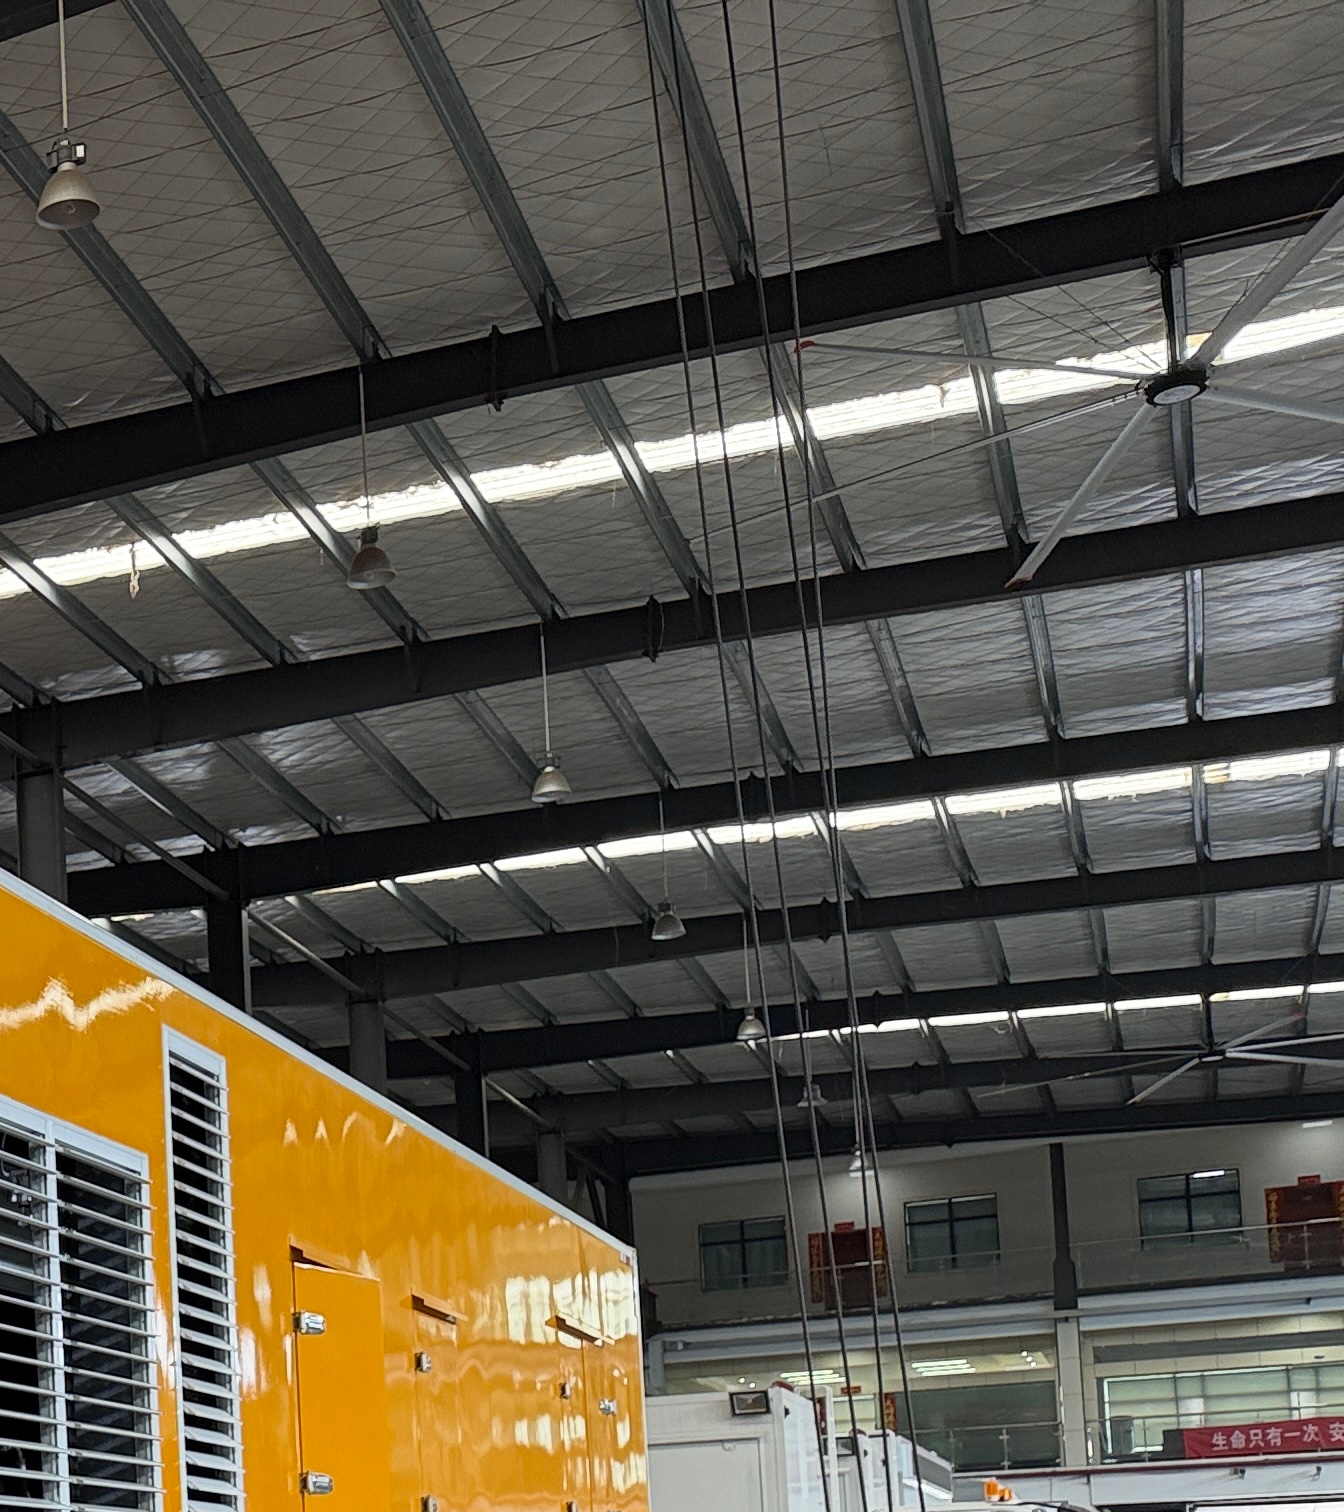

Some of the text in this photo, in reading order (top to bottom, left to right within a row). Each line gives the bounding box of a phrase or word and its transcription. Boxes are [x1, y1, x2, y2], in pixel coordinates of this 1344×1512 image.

[1211, 1424, 1321, 1451] 生命只有一次
